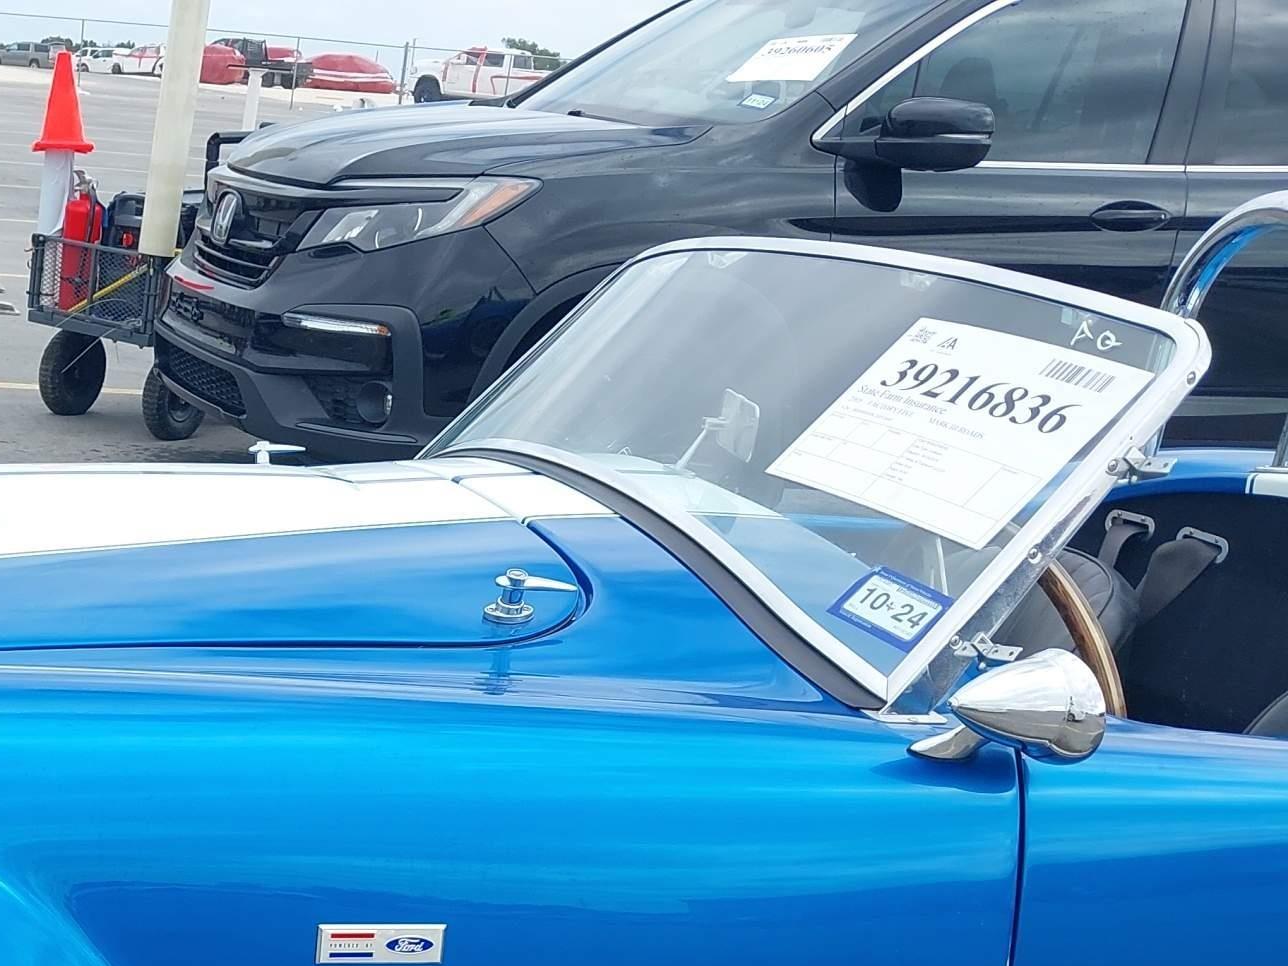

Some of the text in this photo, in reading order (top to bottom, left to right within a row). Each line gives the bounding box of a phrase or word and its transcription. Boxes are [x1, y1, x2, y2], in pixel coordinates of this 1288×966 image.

[880, 359, 1083, 434] 39216836
[903, 395, 948, 415] Insurance
[394, 938, 425, 952] Ford
